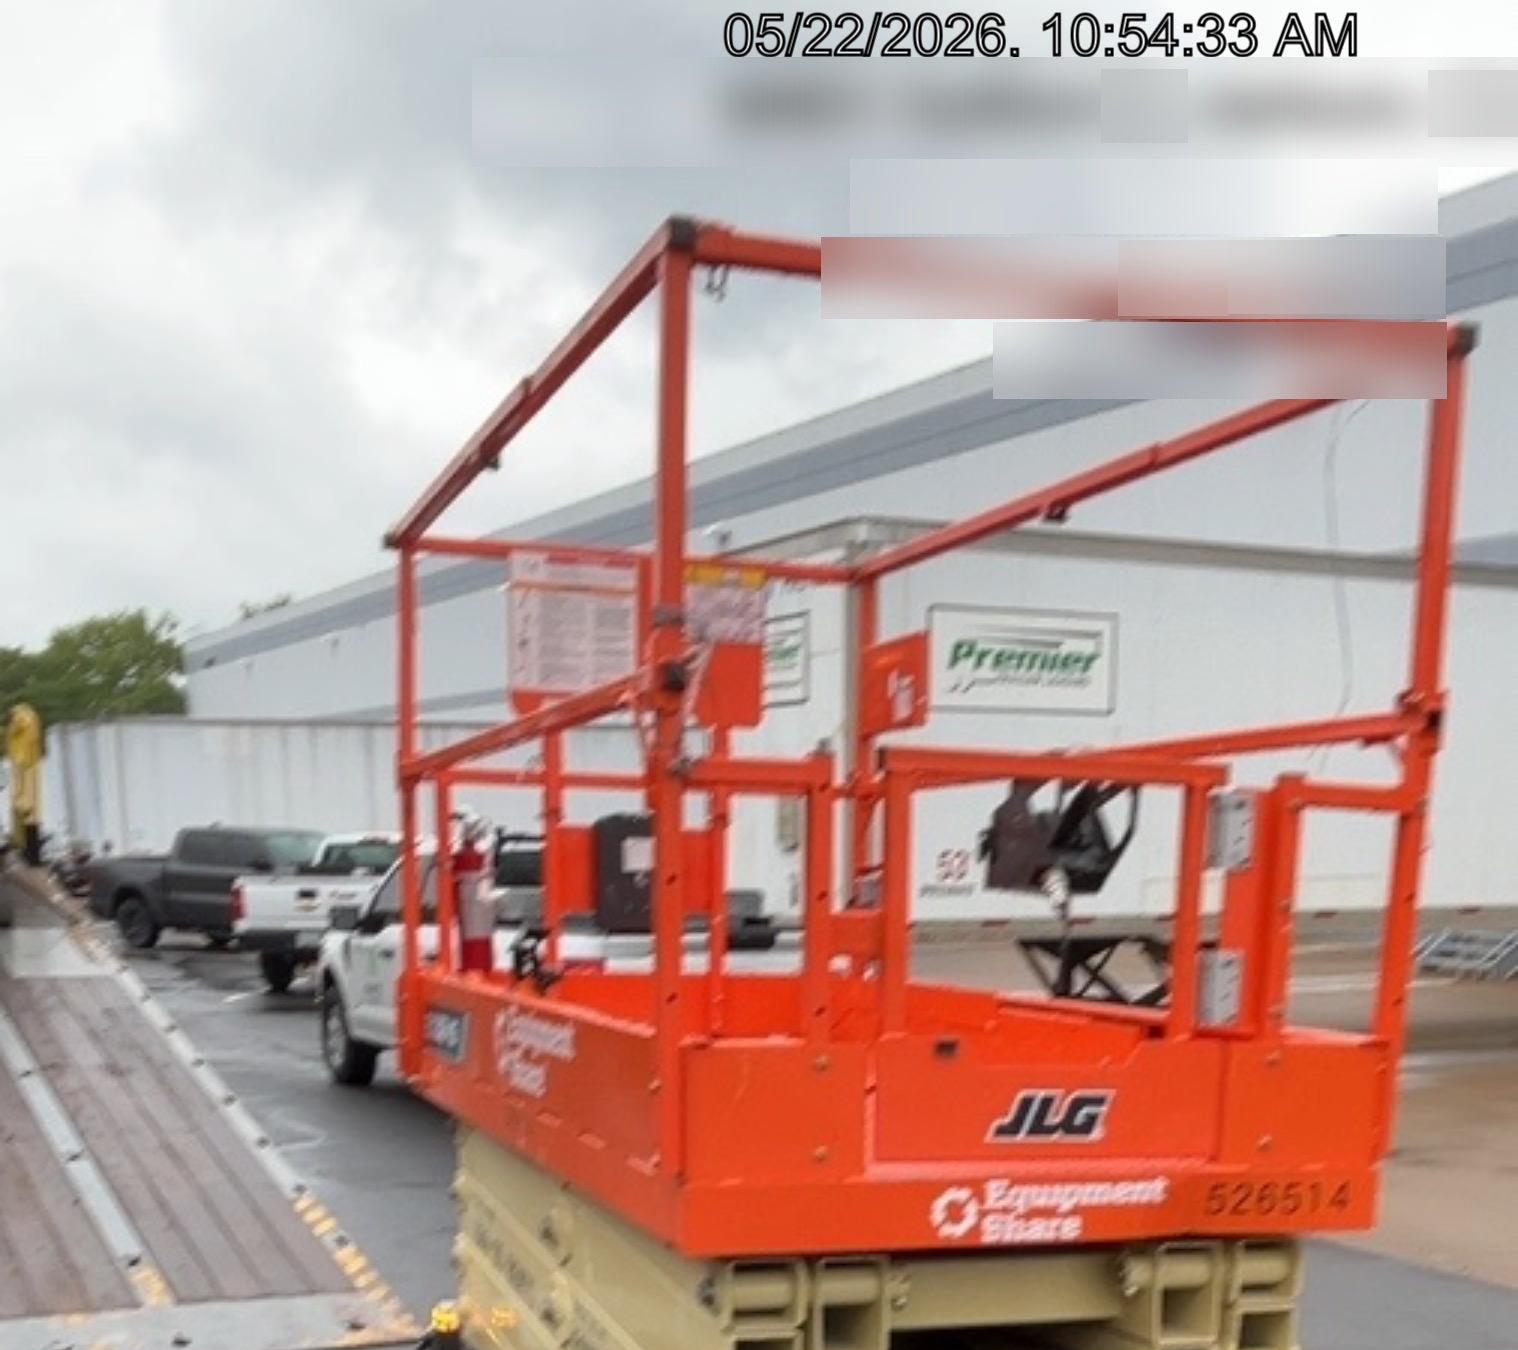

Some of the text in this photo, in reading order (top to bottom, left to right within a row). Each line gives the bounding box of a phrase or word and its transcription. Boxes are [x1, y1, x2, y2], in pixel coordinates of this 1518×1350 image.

[947, 638, 1103, 674] Premier
[990, 1092, 1111, 1138] JLG
[983, 1175, 1169, 1212] Equipment
[1204, 1178, 1352, 1217] 526514
[981, 1213, 1084, 1244] Share
